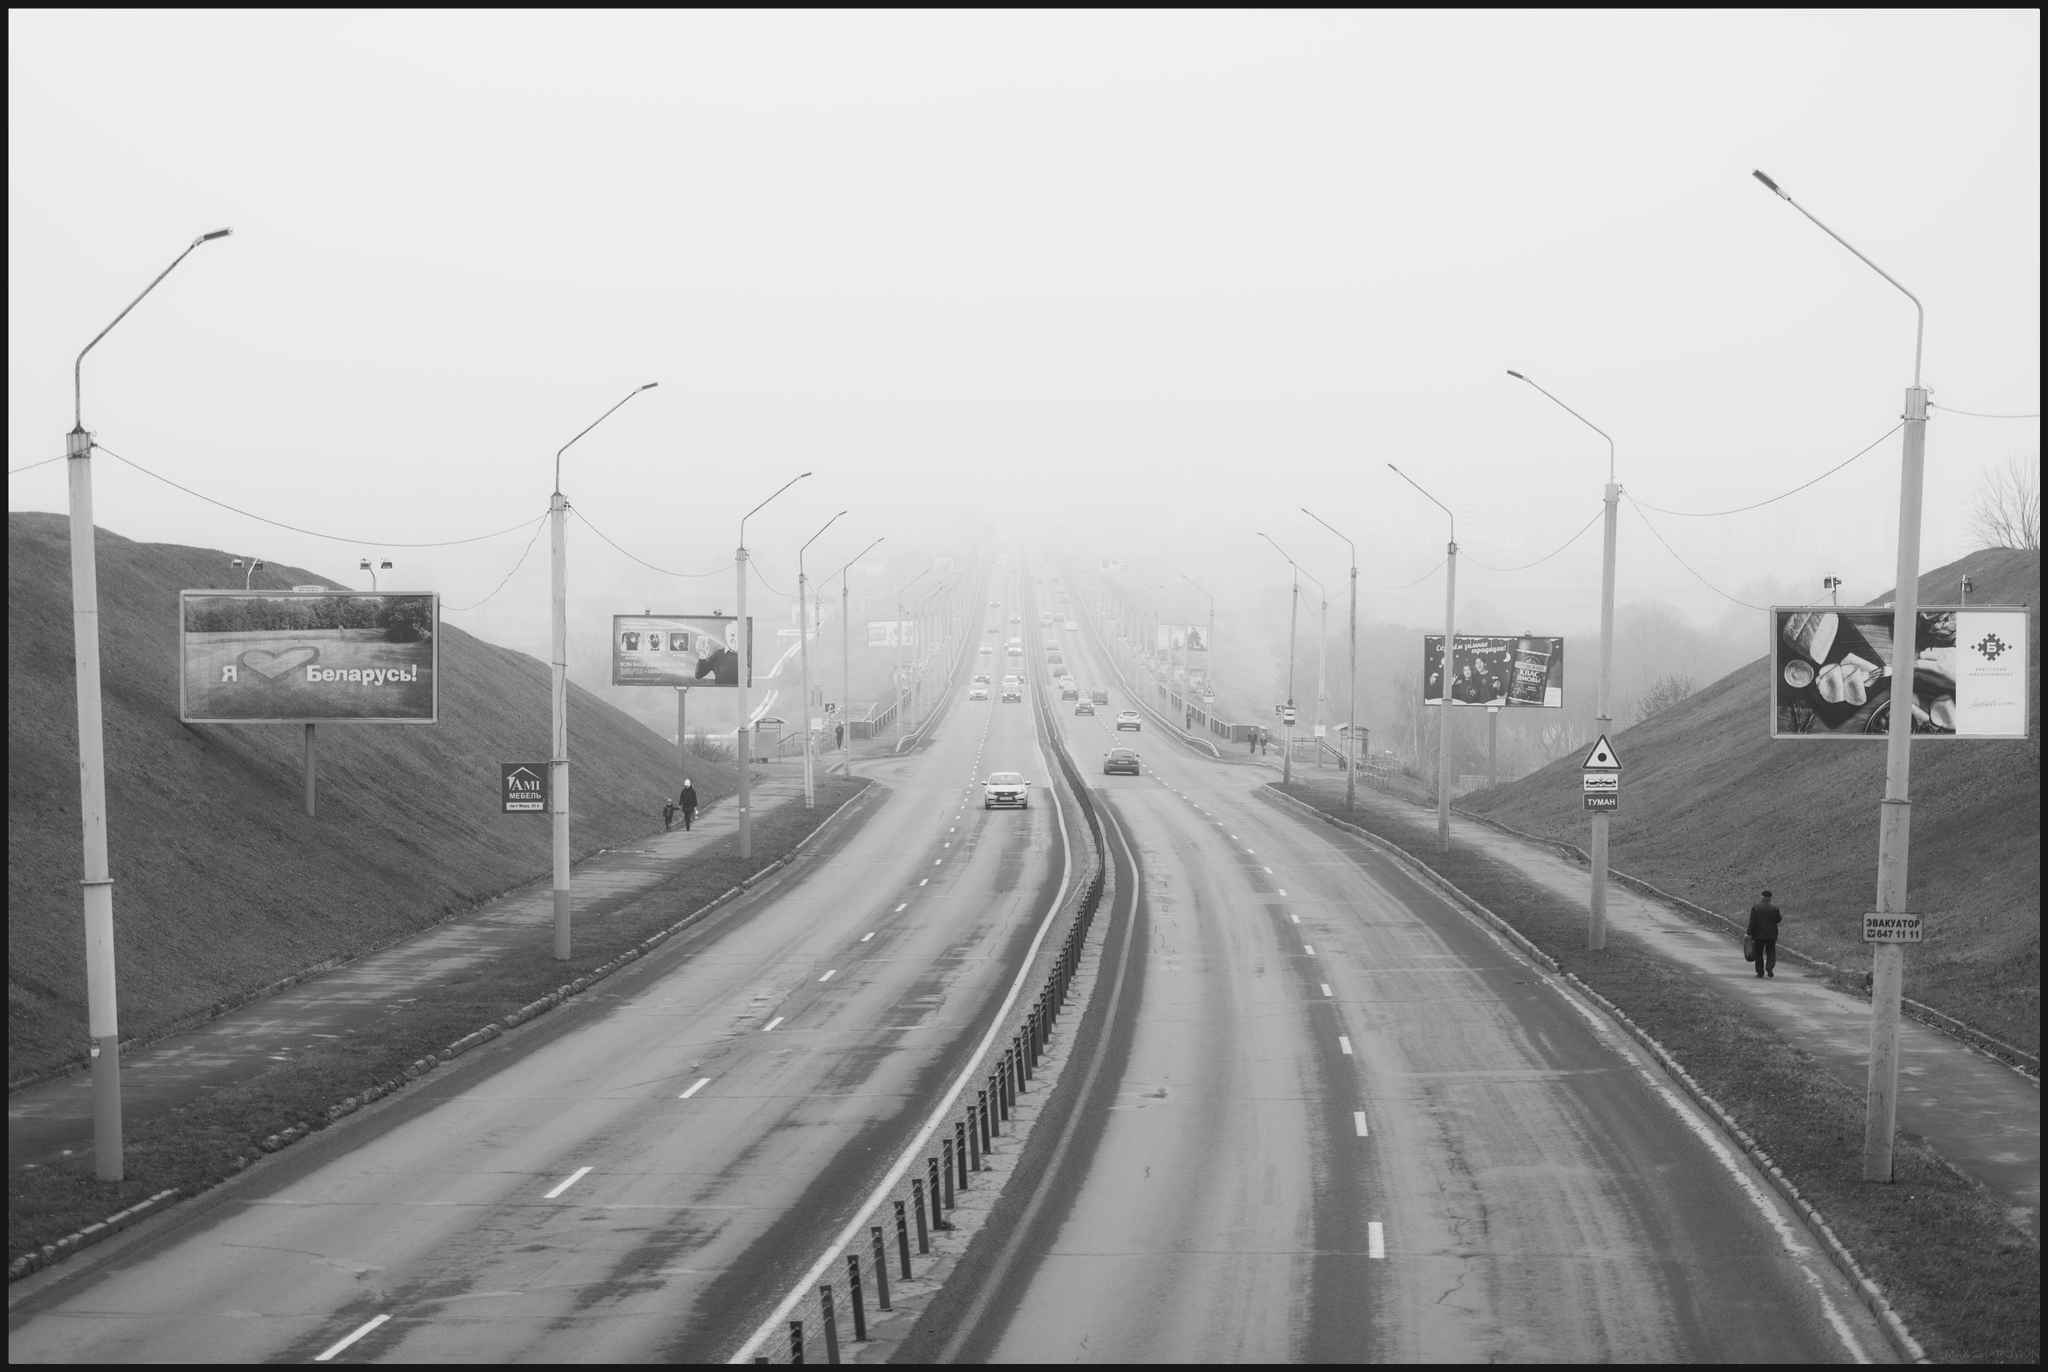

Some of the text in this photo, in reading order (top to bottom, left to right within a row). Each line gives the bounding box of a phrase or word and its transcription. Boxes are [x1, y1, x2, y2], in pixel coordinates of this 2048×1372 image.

[221, 664, 418, 686] Я Беларусь!
[1519, 668, 1540, 678] КВАС
[509, 792, 542, 800] МЕБЕЛЬ
[1586, 798, 1616, 806] ТУМАН
[1866, 918, 1920, 928] ЭВАКУАТОР
[1877, 929, 1919, 939] 647 11 11
